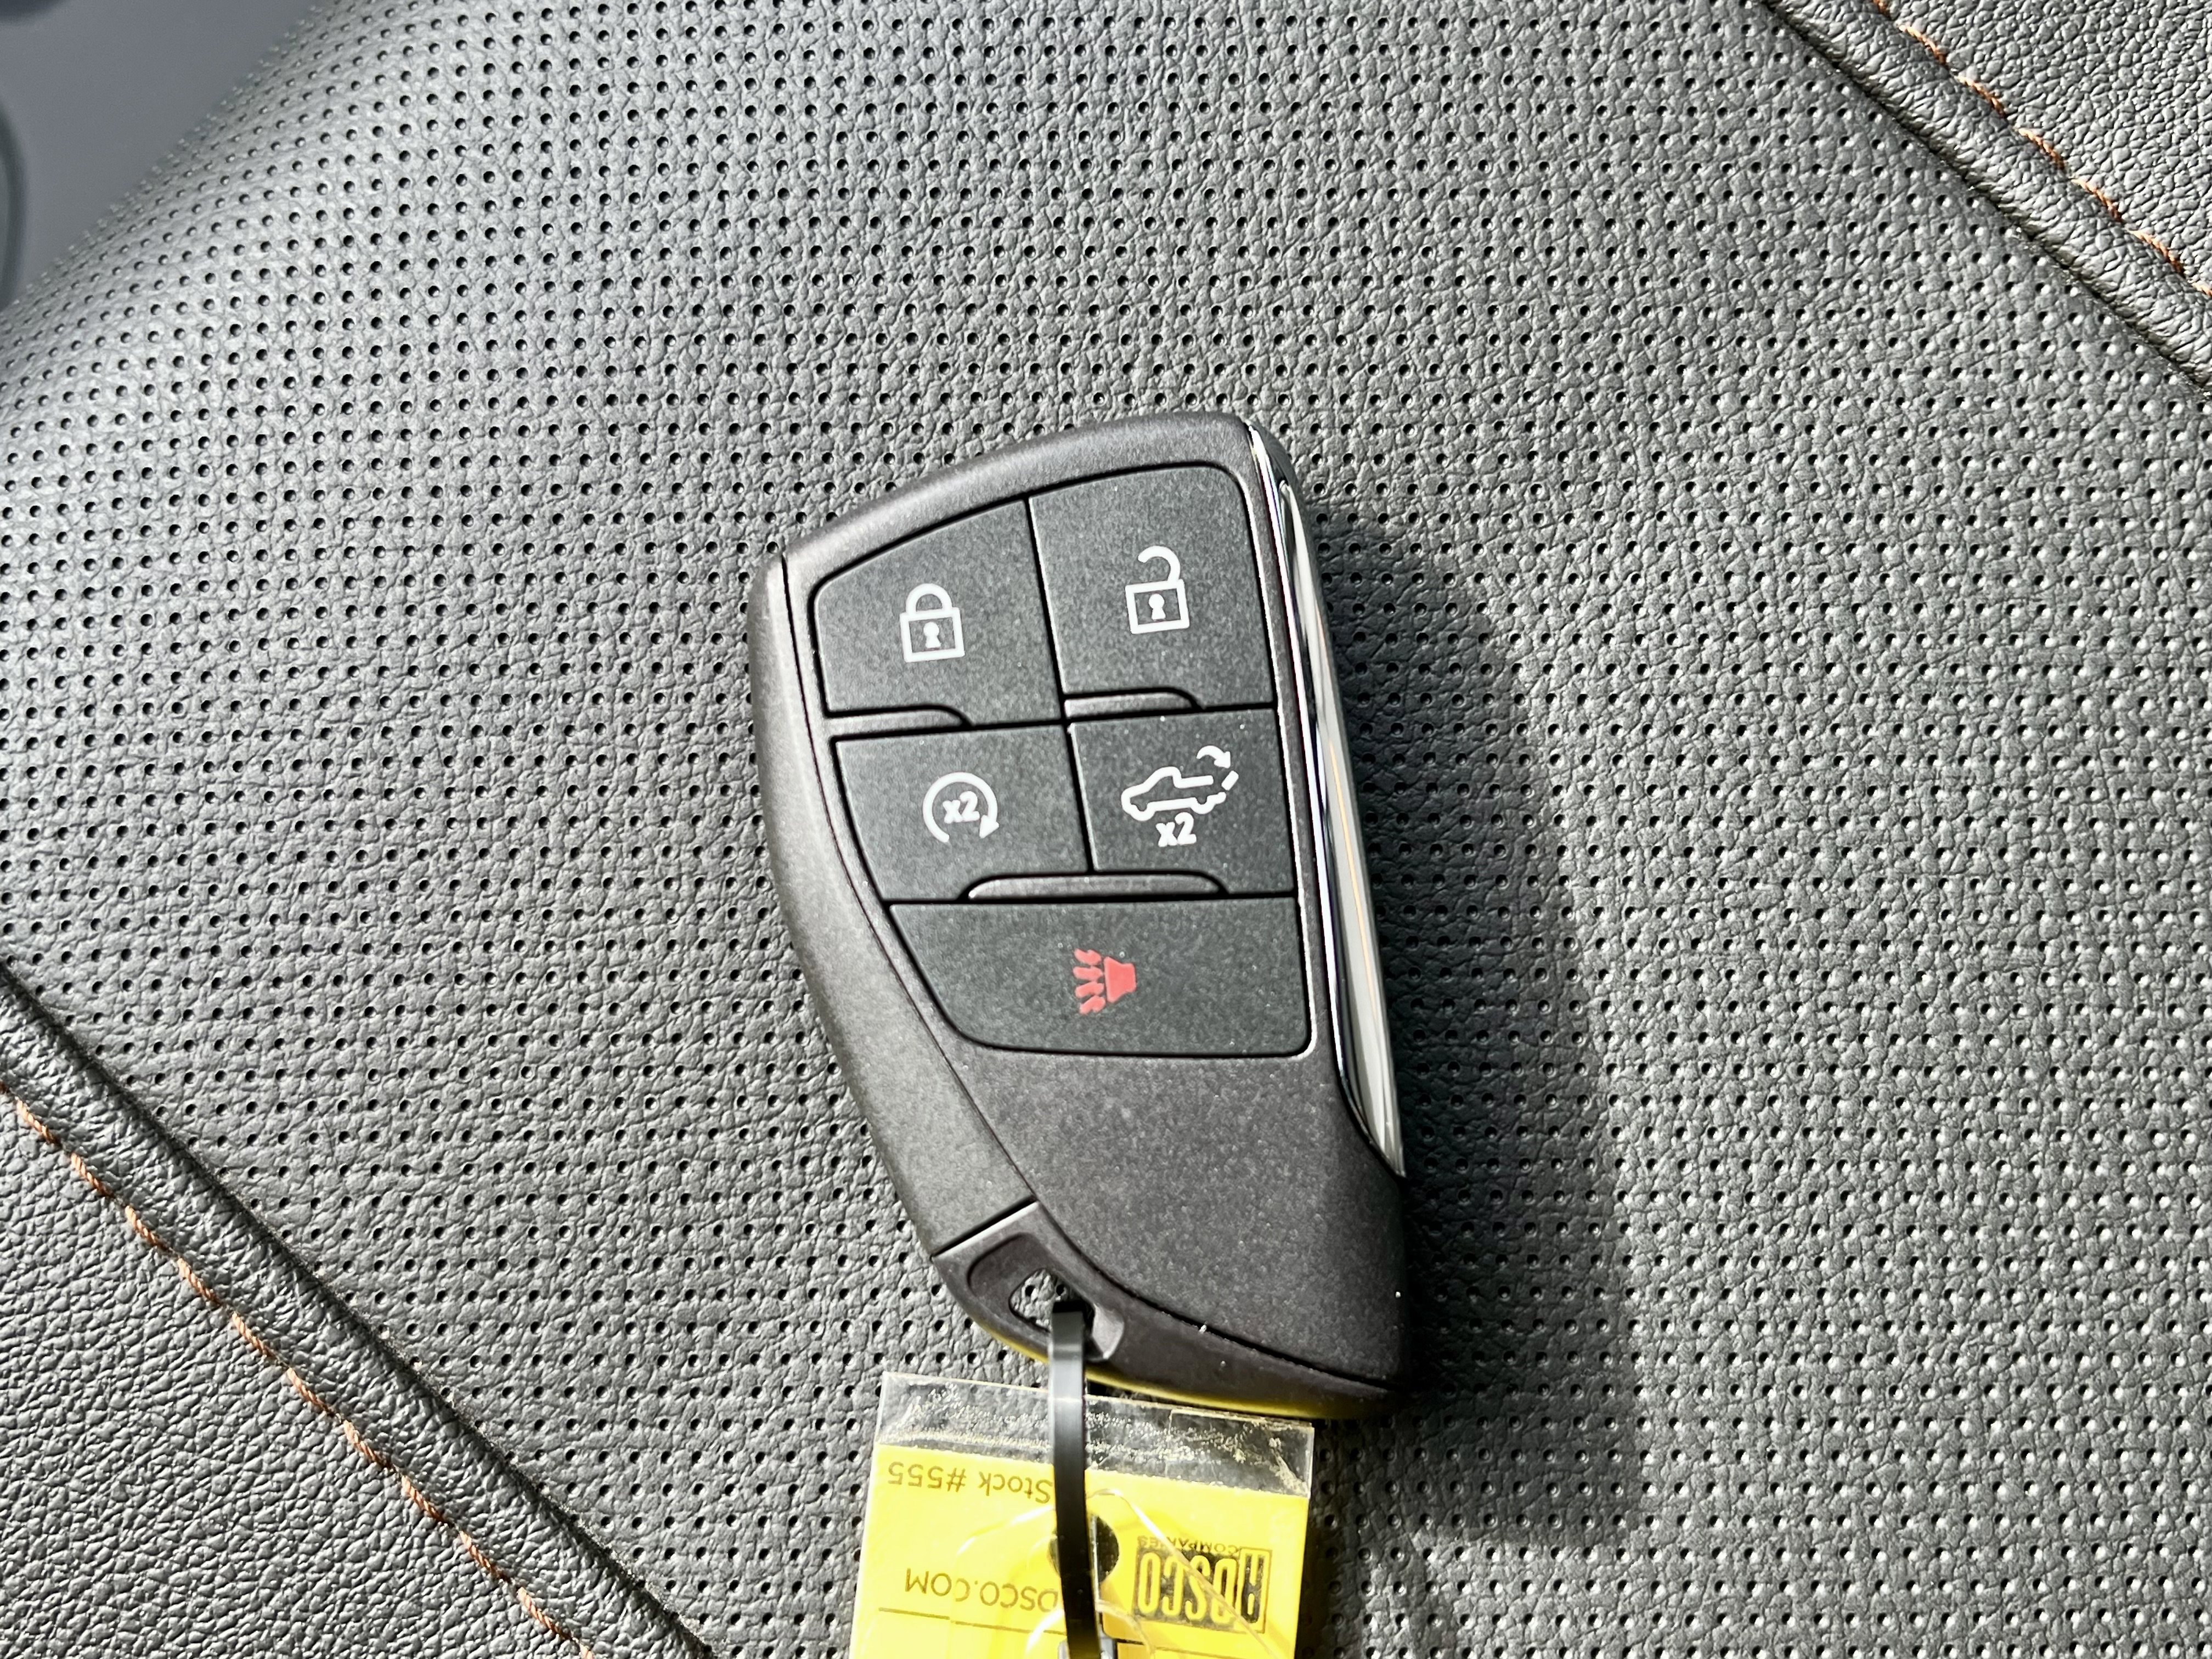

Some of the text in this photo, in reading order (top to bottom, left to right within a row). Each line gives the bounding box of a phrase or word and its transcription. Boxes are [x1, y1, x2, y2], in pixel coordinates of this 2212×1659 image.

[942, 791, 980, 824] x2
[1155, 811, 1197, 848] x2
[888, 1462, 1053, 1504] Stock #555
[1137, 1535, 1239, 1554] COMPANES
[905, 1568, 1059, 1612] DSCO.COM
